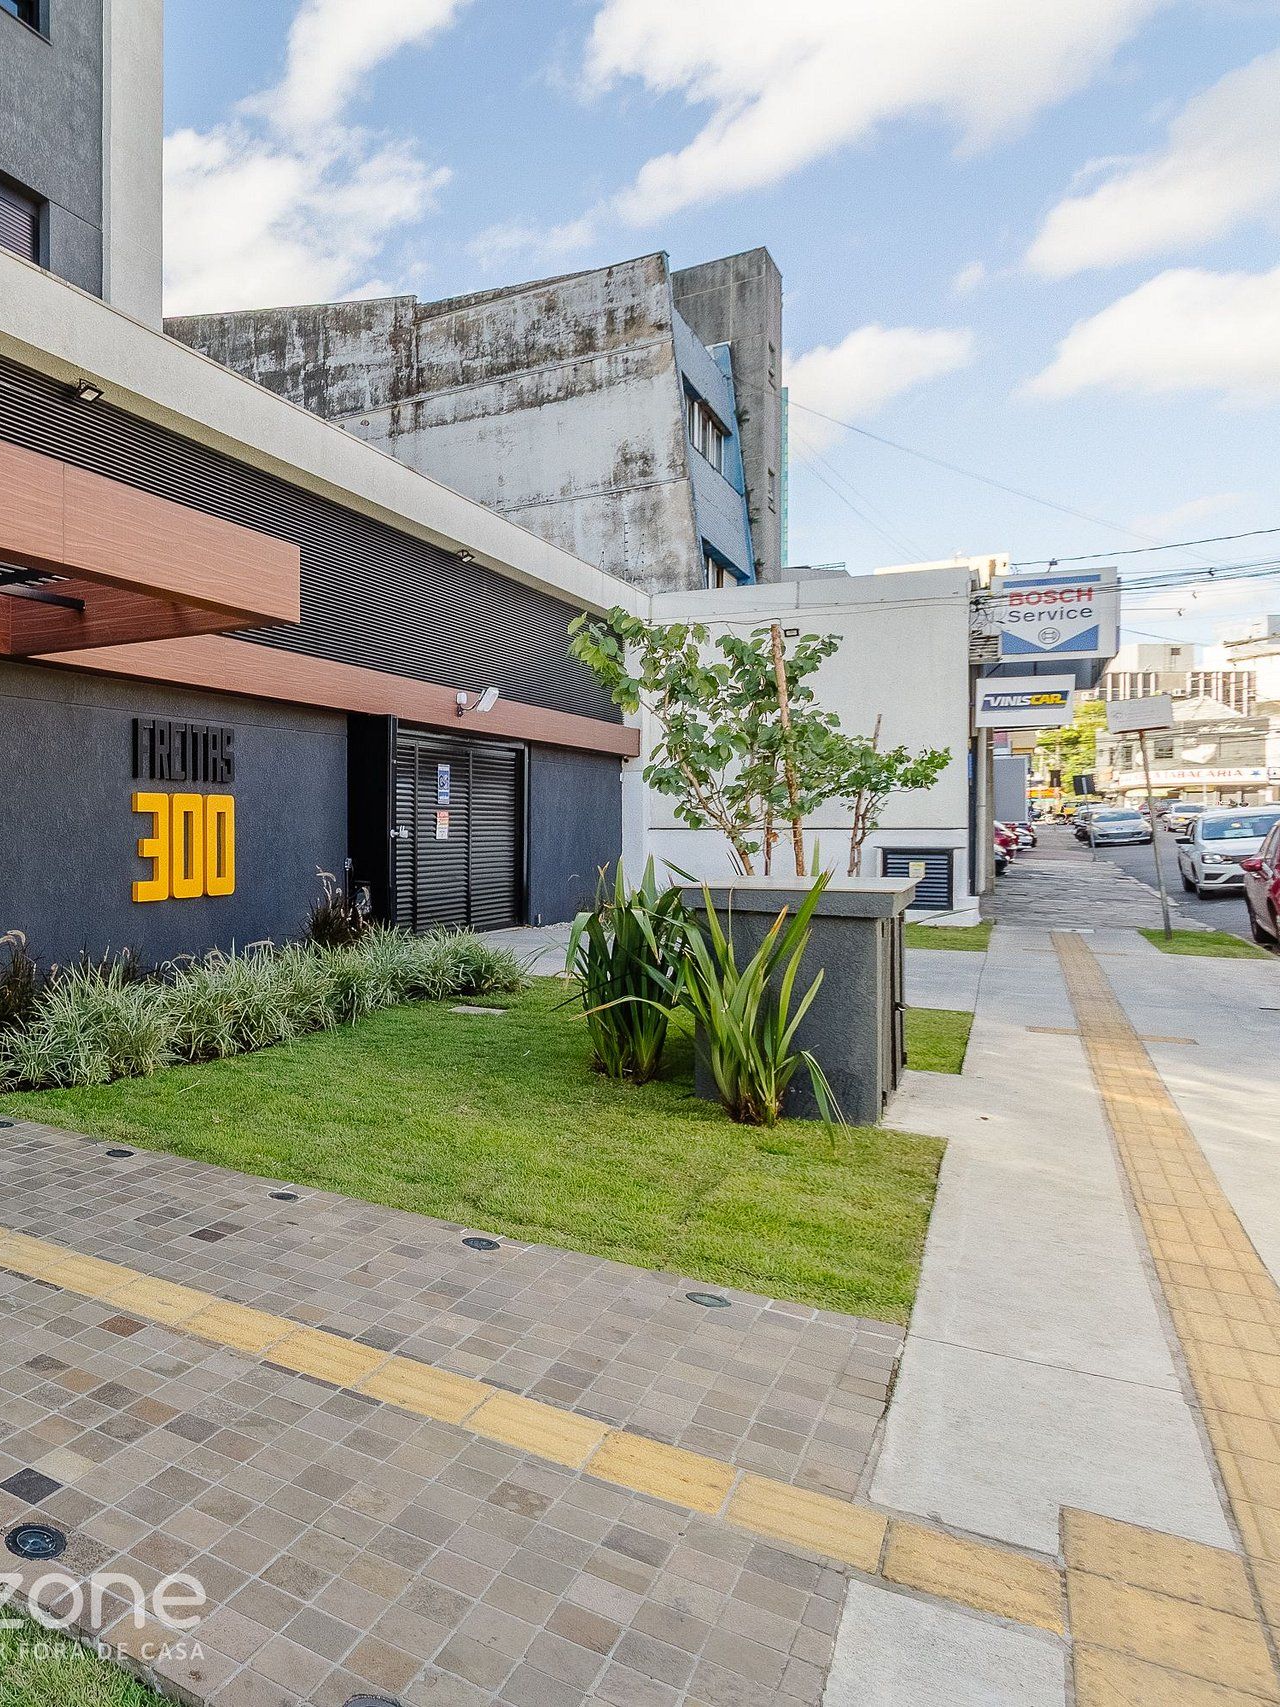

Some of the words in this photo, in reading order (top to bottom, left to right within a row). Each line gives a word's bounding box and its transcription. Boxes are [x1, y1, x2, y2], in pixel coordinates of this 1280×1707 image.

[1009, 587, 1093, 606] BOSCH
[1008, 607, 1093, 623] Service
[983, 693, 1067, 707] VINISCAR
[132, 717, 235, 783] FREITAS
[131, 791, 236, 903] 300
